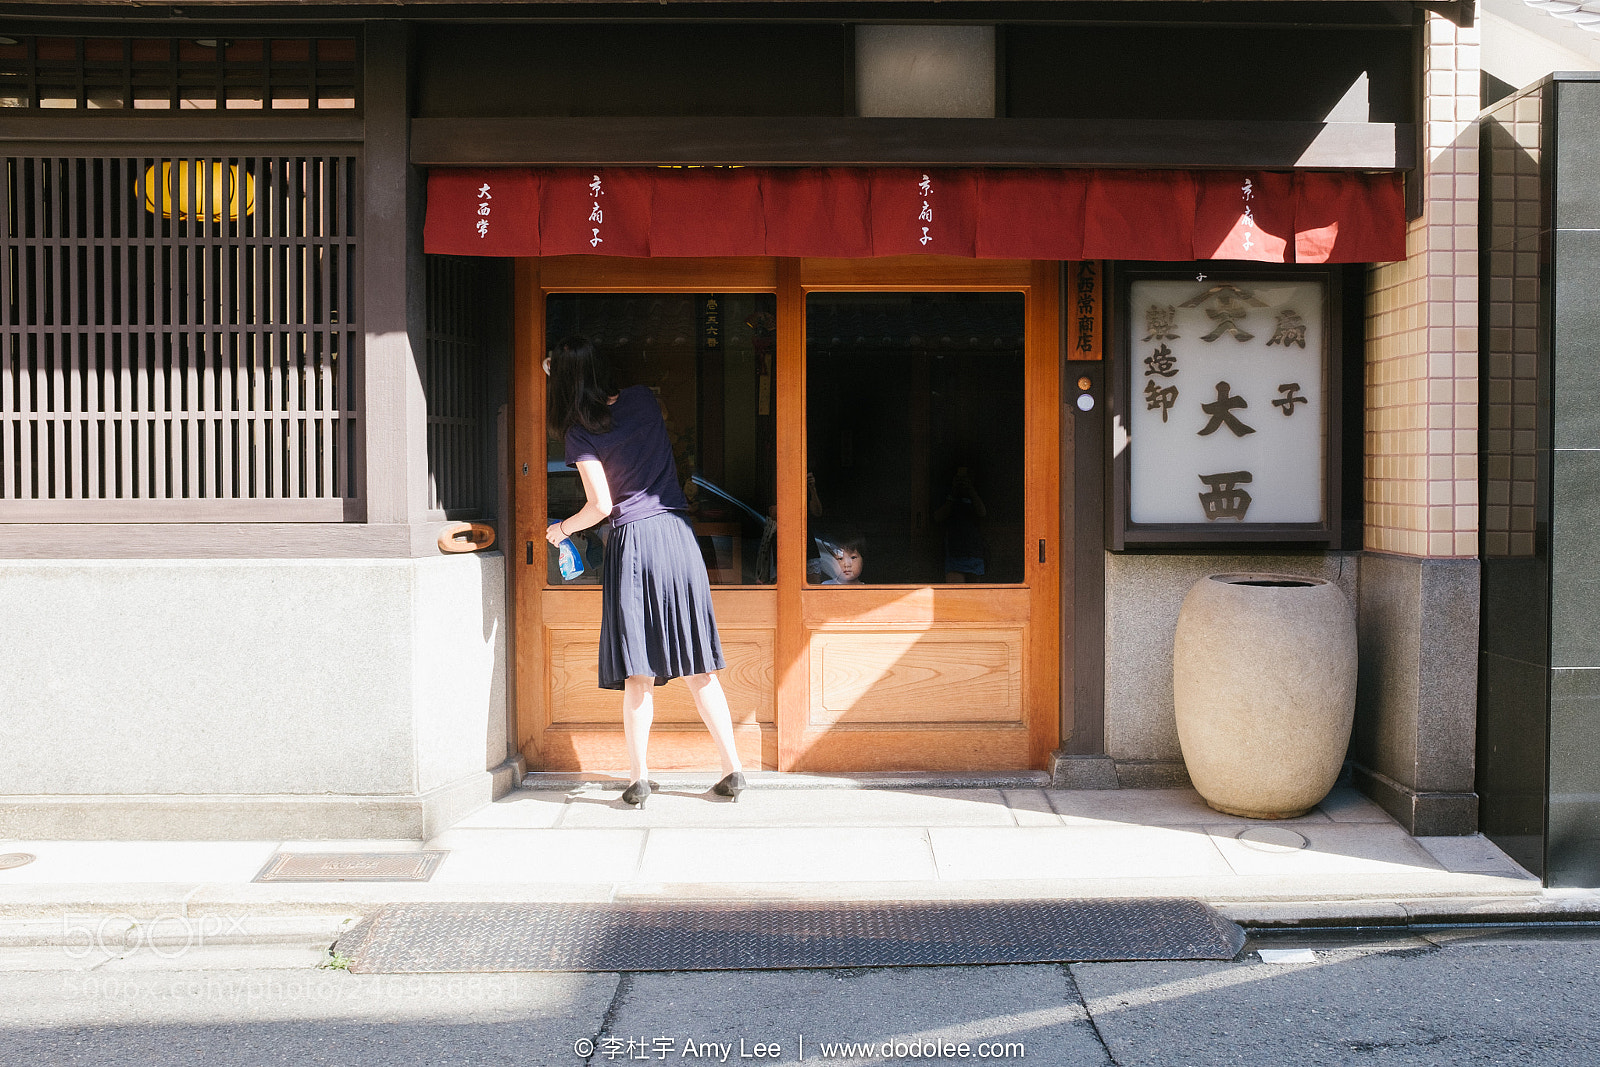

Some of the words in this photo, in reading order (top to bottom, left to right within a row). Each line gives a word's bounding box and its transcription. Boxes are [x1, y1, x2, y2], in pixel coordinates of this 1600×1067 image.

[476, 183, 492, 239] 大西常
[588, 175, 604, 247] 京扇子
[918, 174, 934, 246] 京扇子
[1241, 178, 1255, 252] 京扇子
[1266, 309, 1308, 417] 扇子
